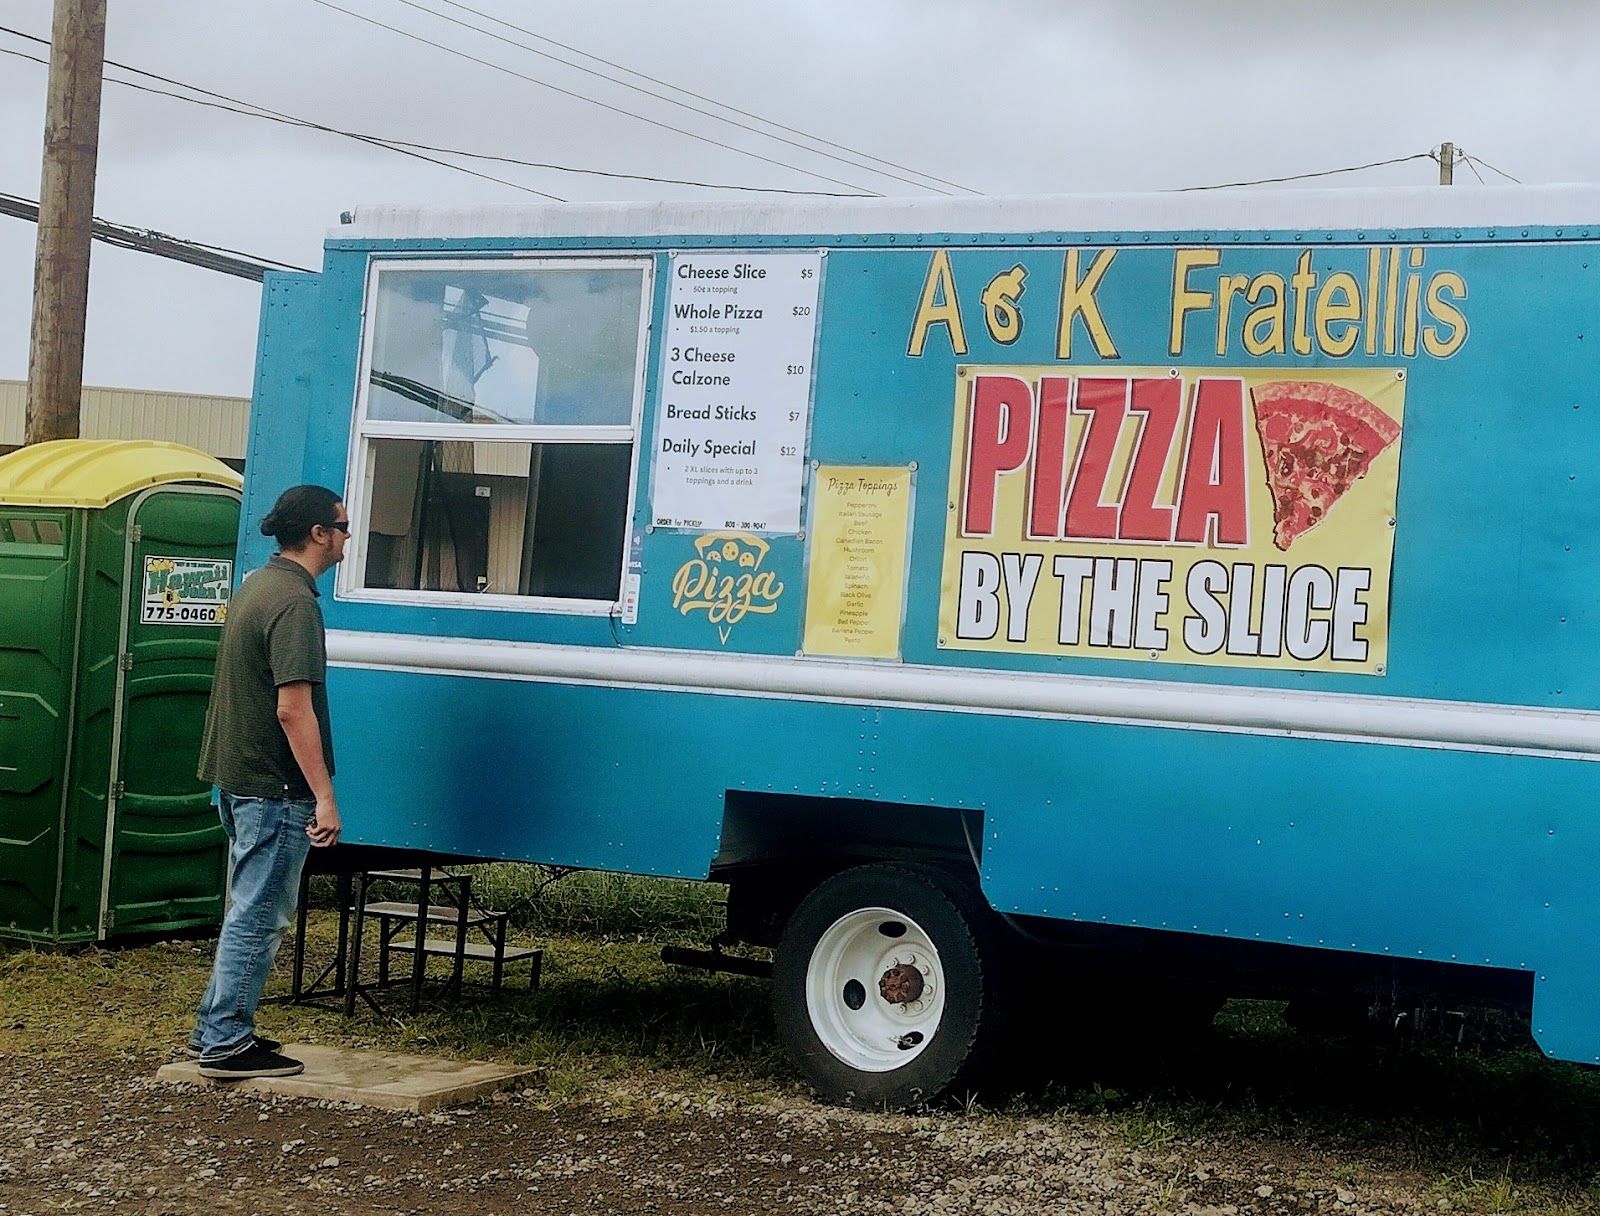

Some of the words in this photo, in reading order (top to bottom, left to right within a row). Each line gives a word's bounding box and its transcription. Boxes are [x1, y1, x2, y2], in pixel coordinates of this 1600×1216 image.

[677, 264, 730, 279] Cheese
[733, 264, 767, 279] Slice
[800, 268, 813, 280] $5
[712, 286, 738, 295] topping
[674, 303, 721, 319] Whole
[724, 304, 763, 319] Pizza
[792, 306, 811, 317] $20
[906, 247, 967, 357] A
[1055, 247, 1120, 360] K
[1167, 247, 1470, 359] Fratellis
[690, 326, 708, 334] $1.50
[714, 326, 740, 335] topping
[670, 347, 680, 362] 3
[684, 347, 736, 363] Cheese
[672, 370, 731, 386] Calzone
[786, 365, 804, 376] $10
[667, 404, 711, 420] Bread
[714, 405, 757, 421] Sticks
[788, 411, 800, 422] $7
[662, 438, 700, 457] Daily
[703, 440, 756, 458] Special
[780, 446, 797, 457] $12
[961, 374, 1251, 548] PIZZA
[700, 466, 718, 474] slices
[686, 477, 716, 486] toppings
[828, 478, 855, 495] Pizza
[858, 479, 898, 496] Toppings
[672, 559, 784, 624] Pizza
[146, 606, 216, 621] 775-0460
[956, 551, 1044, 643] BY
[1054, 557, 1173, 650] THE
[1183, 561, 1371, 661] SLICE
